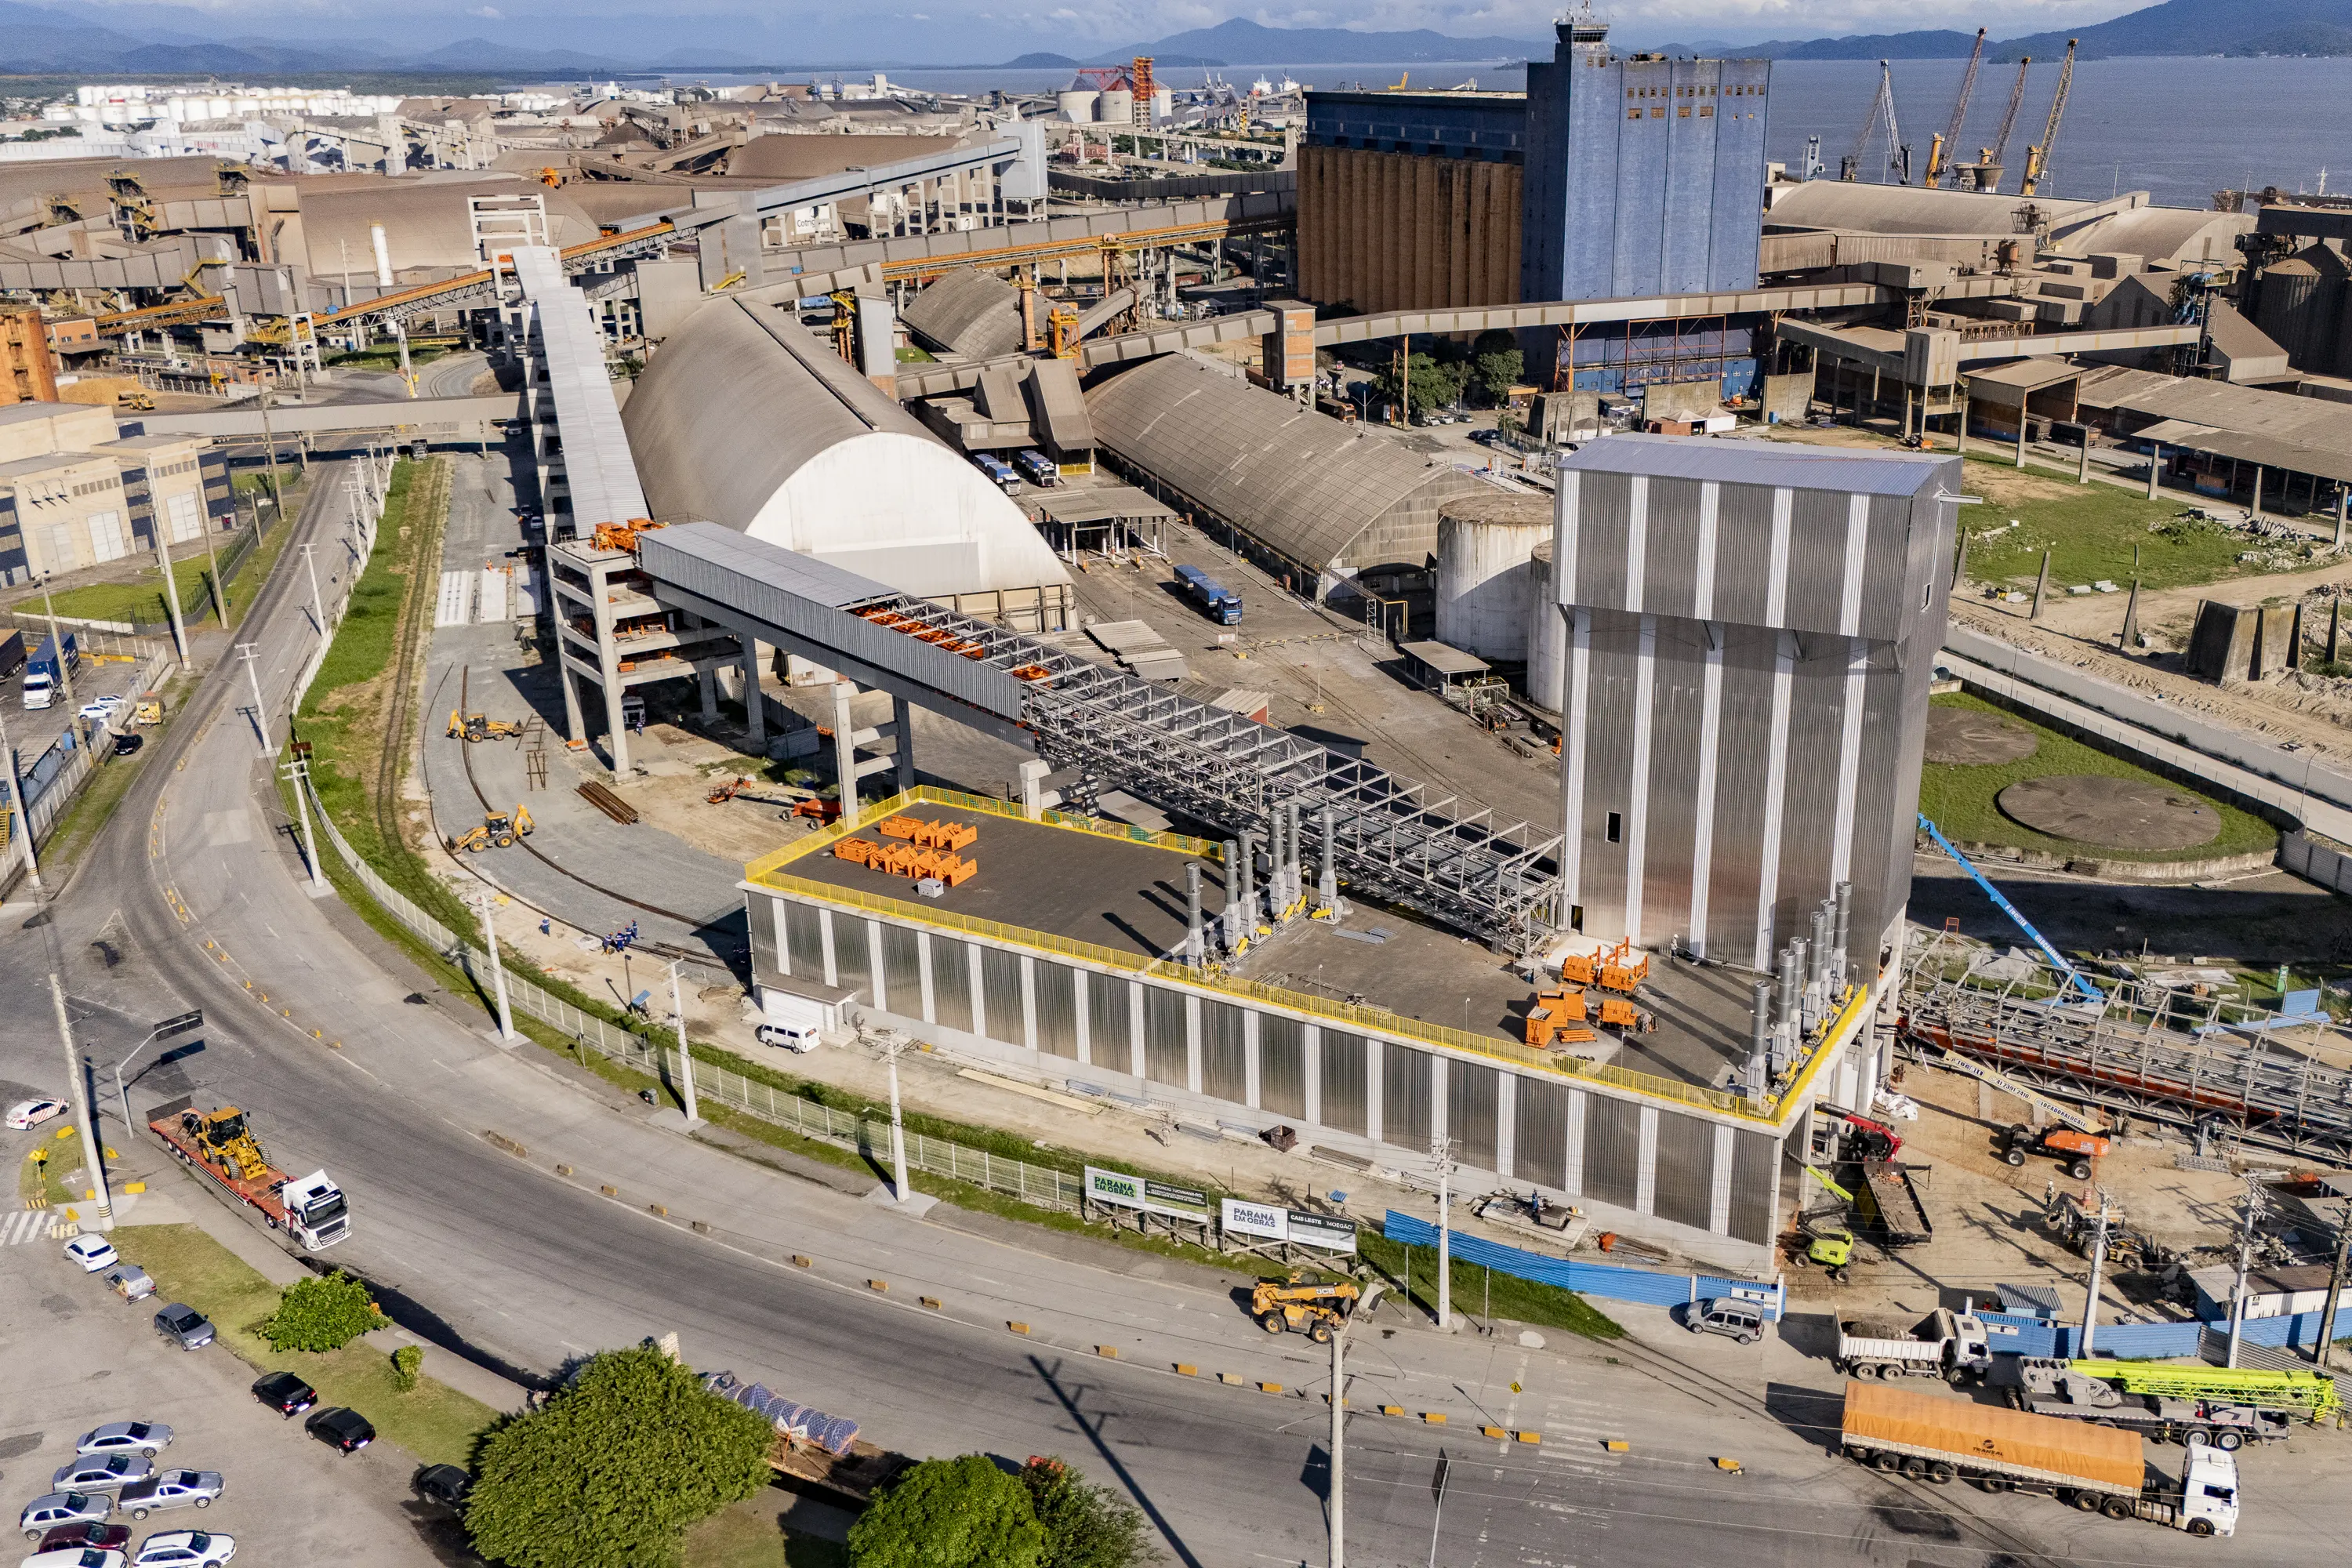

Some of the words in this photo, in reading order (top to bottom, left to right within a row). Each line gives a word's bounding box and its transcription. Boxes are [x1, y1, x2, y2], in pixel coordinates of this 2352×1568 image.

[1094, 1176, 1134, 1192] PARANÁ
[1108, 1186, 1134, 1197] OBRAS
[1234, 1207, 1276, 1221] PARANÁ
[1247, 1218, 1276, 1227] OBRAS
